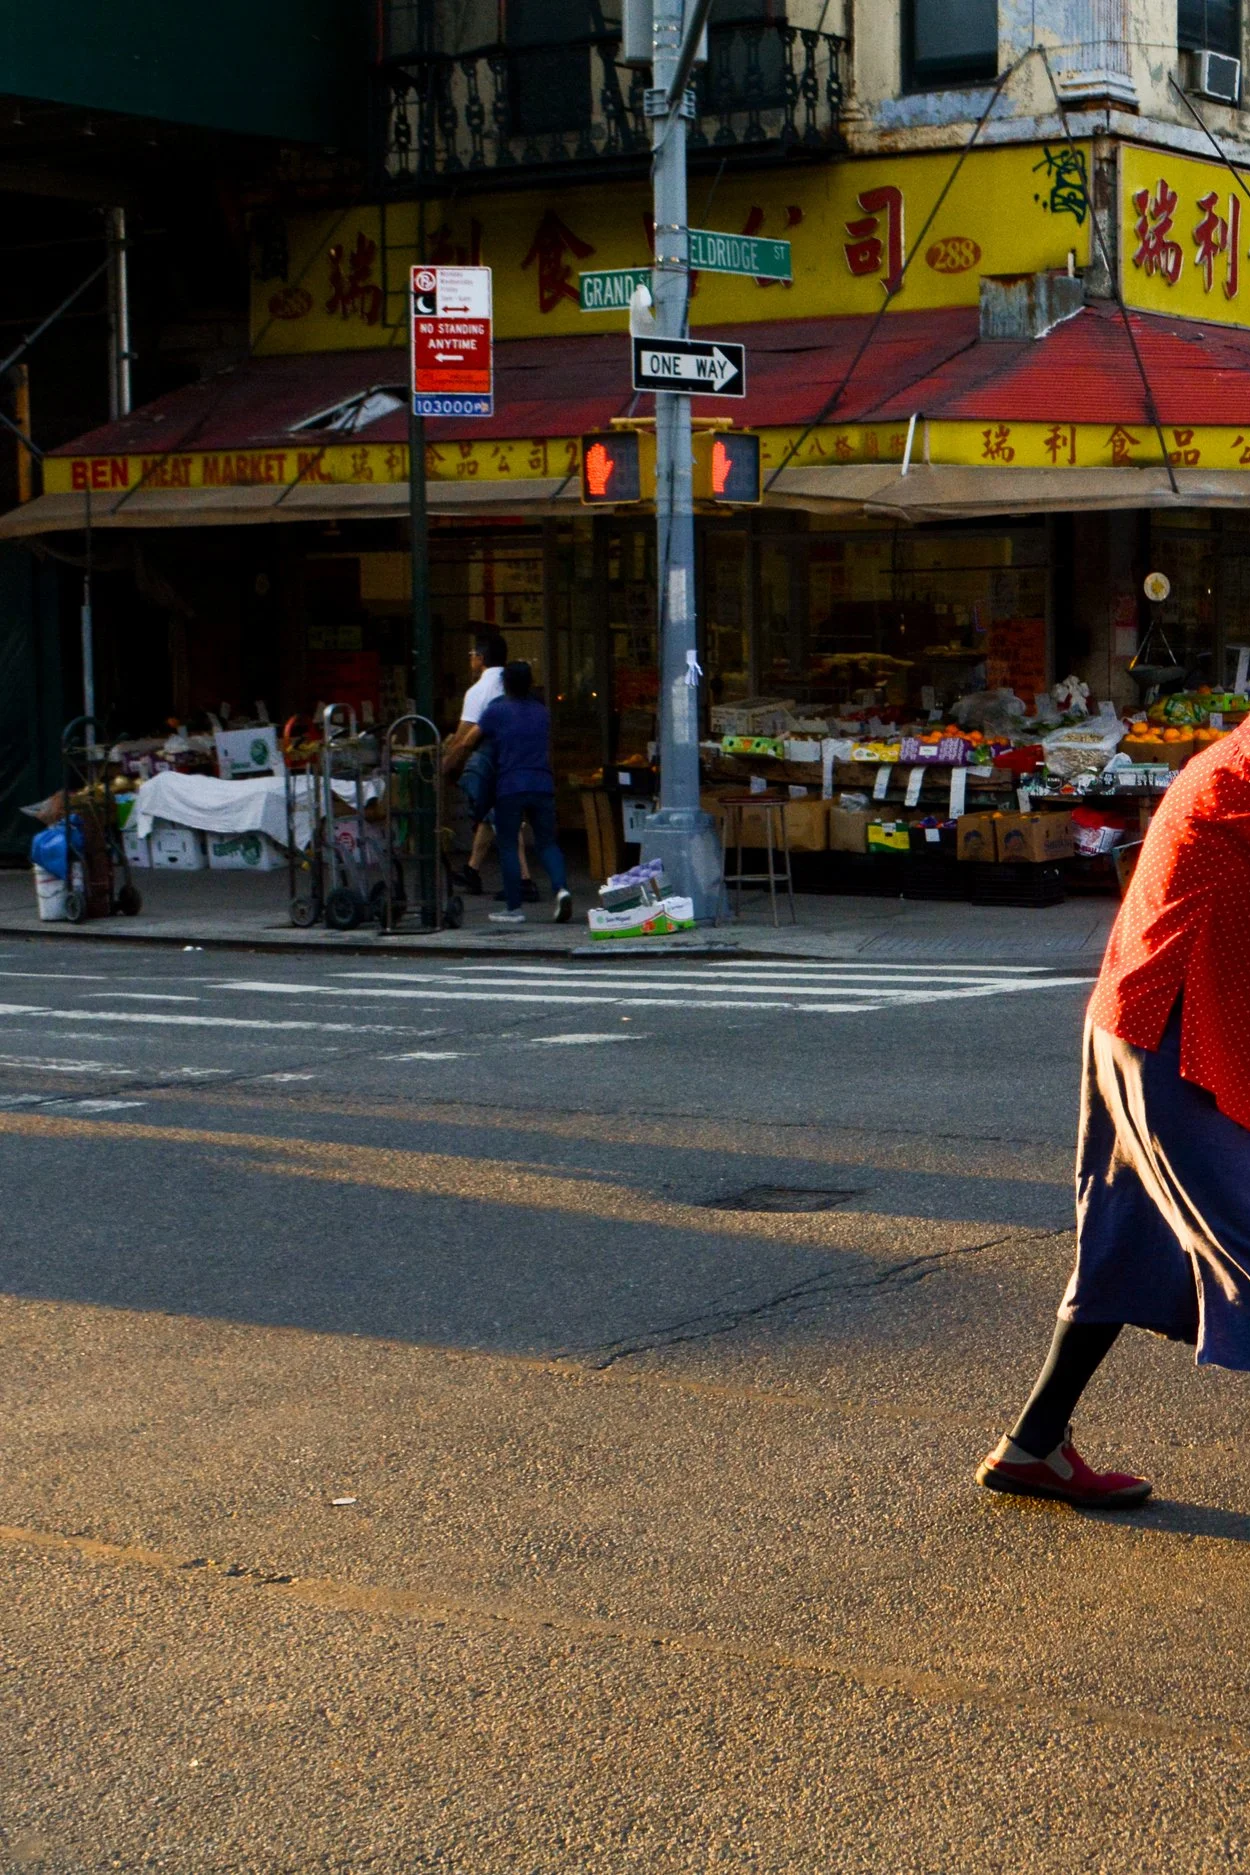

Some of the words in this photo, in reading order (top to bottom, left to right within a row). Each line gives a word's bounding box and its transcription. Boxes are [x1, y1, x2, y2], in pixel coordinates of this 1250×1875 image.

[689, 235, 760, 271] ELDRIDGE
[773, 244, 786, 261] ST
[934, 239, 976, 270] 288
[583, 275, 635, 308] GRAND
[419, 323, 434, 334] NO
[438, 323, 485, 335] STANDING
[427, 339, 478, 350] ANYTIME
[650, 354, 682, 376] ONE
[696, 358, 728, 380] WAY
[416, 400, 474, 414] 103000
[71, 457, 129, 490] BEN
[142, 454, 193, 488] MEAT
[201, 452, 288, 486] MARKET
